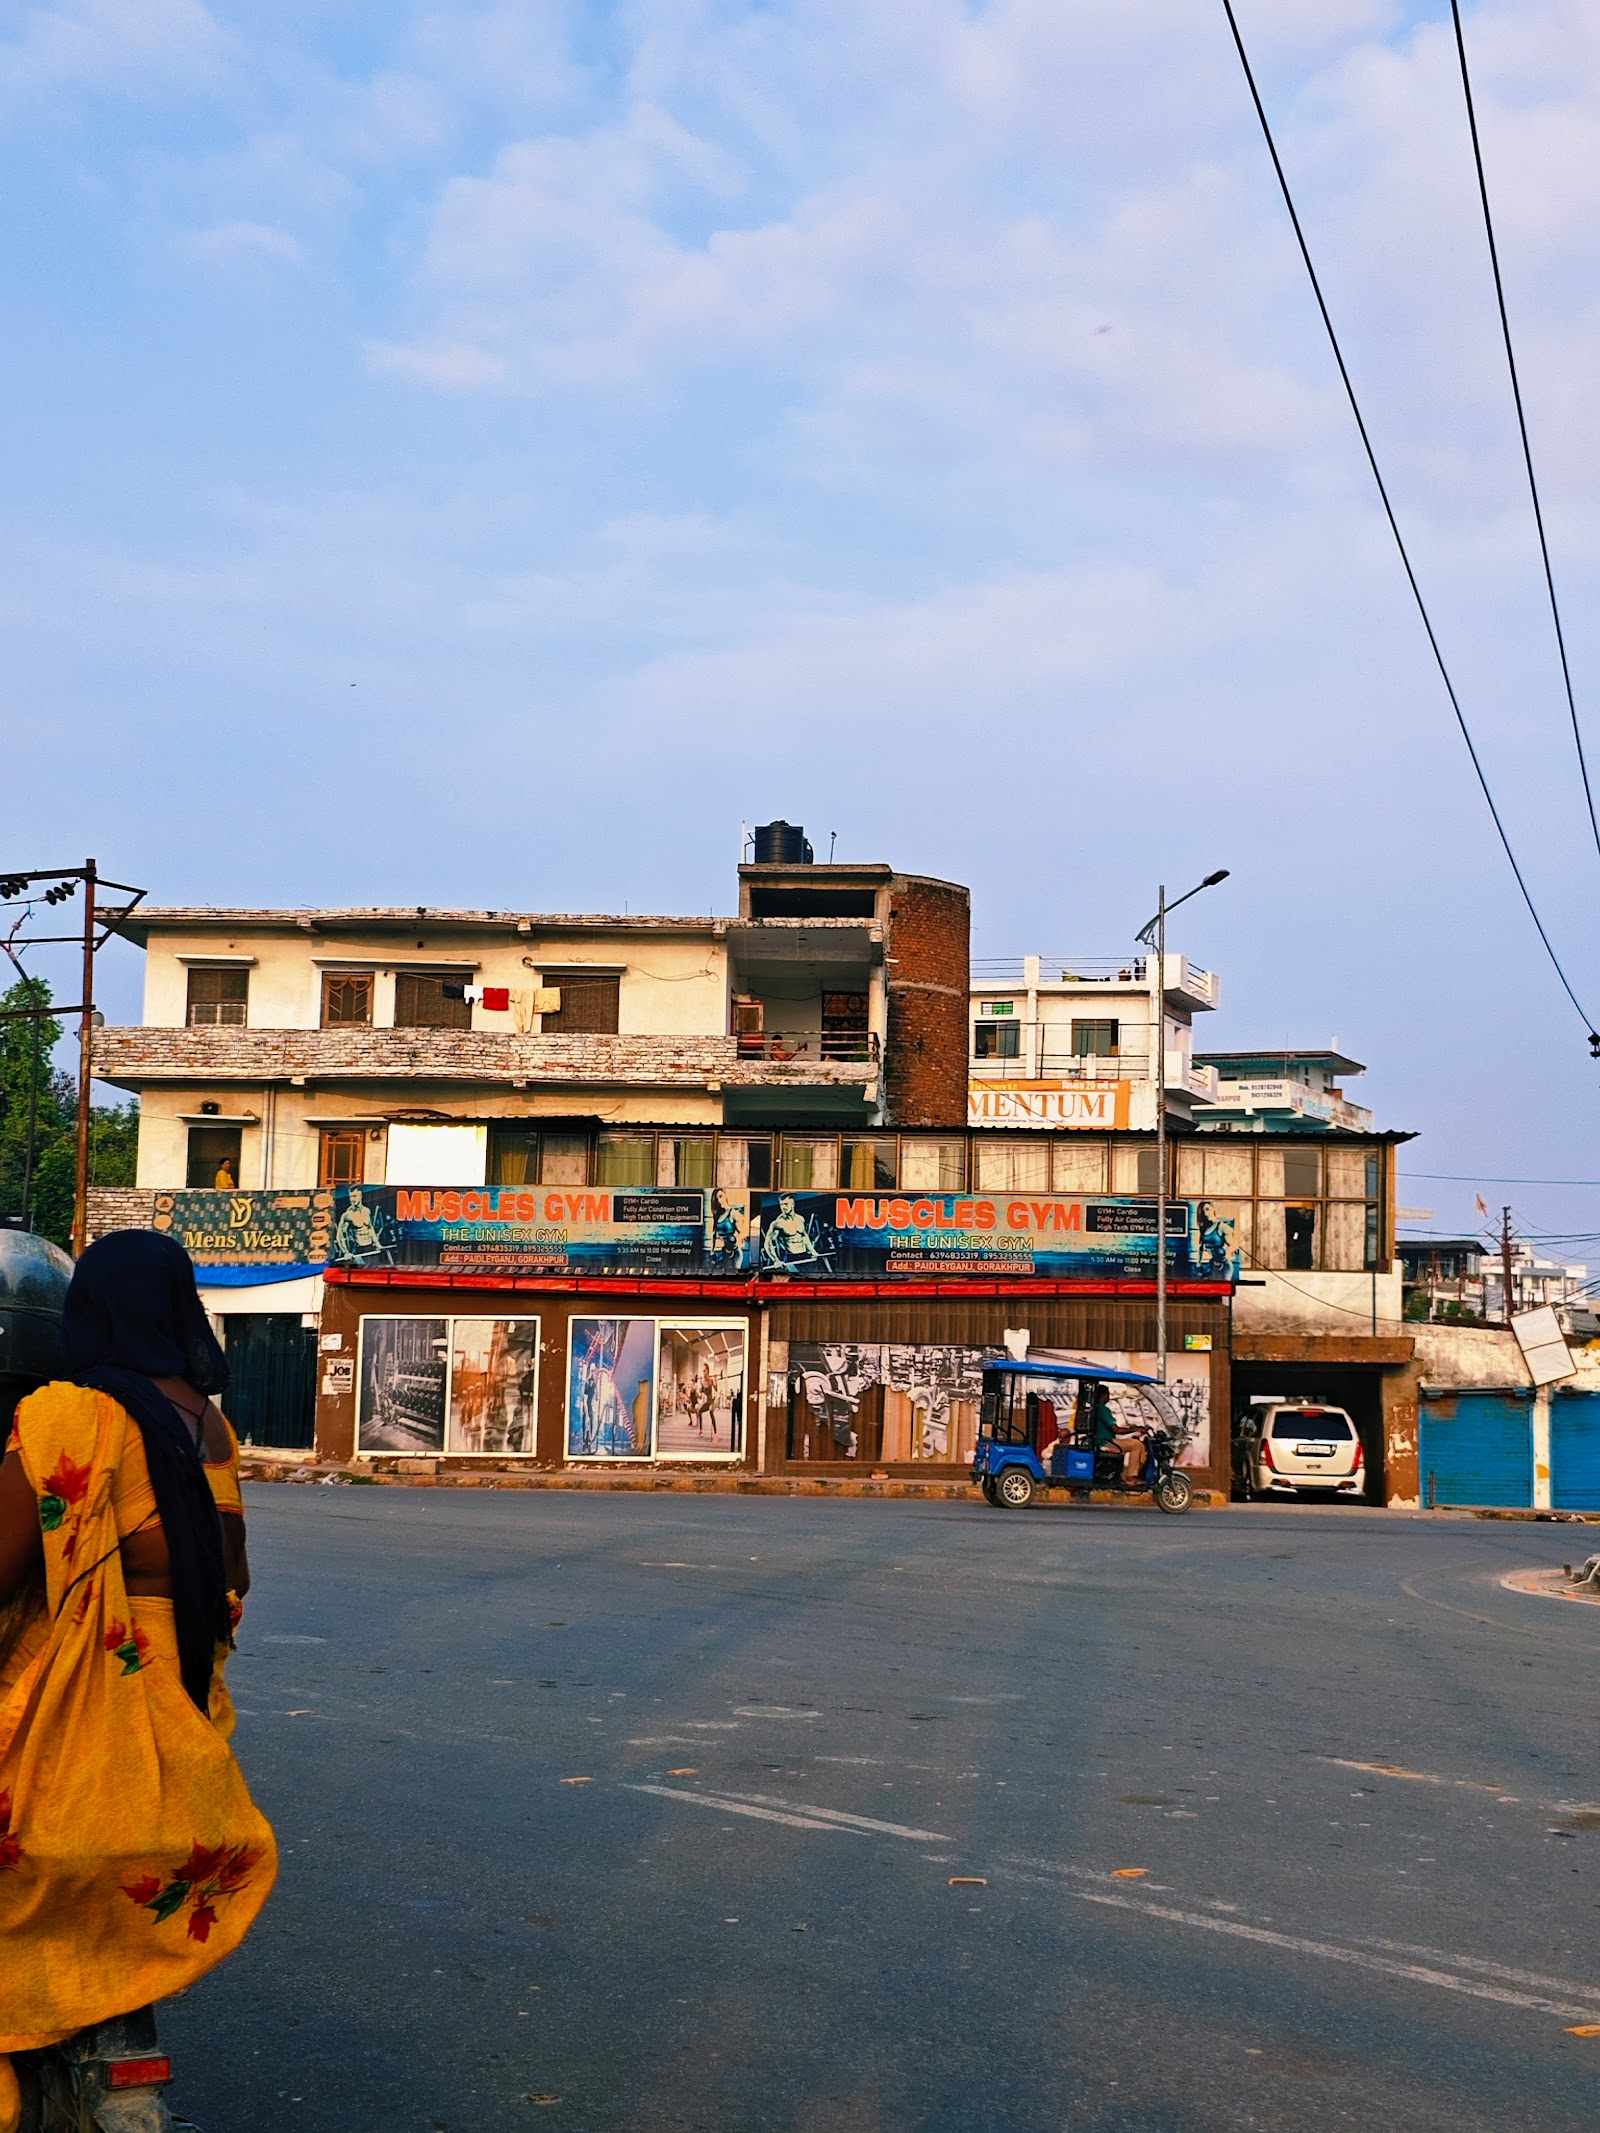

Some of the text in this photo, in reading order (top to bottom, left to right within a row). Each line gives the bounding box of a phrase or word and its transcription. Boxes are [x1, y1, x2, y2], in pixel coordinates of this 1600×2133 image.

[1086, 1080, 1096, 1091] 20
[968, 1093, 1107, 1118] MENTUM
[640, 1197, 660, 1205] Cardio
[396, 1190, 610, 1223] MUSCLES GYM
[623, 1205, 638, 1214] Fully
[835, 1197, 1082, 1232] MUSCLES GYM
[1116, 1208, 1139, 1216] Cardio
[623, 1214, 637, 1222] High
[1096, 1215, 1114, 1224] Fully
[1125, 1216, 1157, 1224] Condition
[1096, 1223, 1112, 1232] High
[1112, 1224, 1129, 1232] Tech
[183, 1230, 293, 1249] Mens Wear
[440, 1227, 569, 1243] THE UNISEX GYM
[887, 1234, 1035, 1252] THE UNISEX GYM
[443, 1243, 472, 1253] Contact
[671, 1247, 692, 1256] Sunday
[517, 1255, 565, 1264] GORAKHPUR
[645, 1255, 662, 1263] Close
[890, 1250, 924, 1260] Contact
[976, 1263, 1031, 1272] GORAKHPUR
[1123, 1265, 1142, 1273] Close
